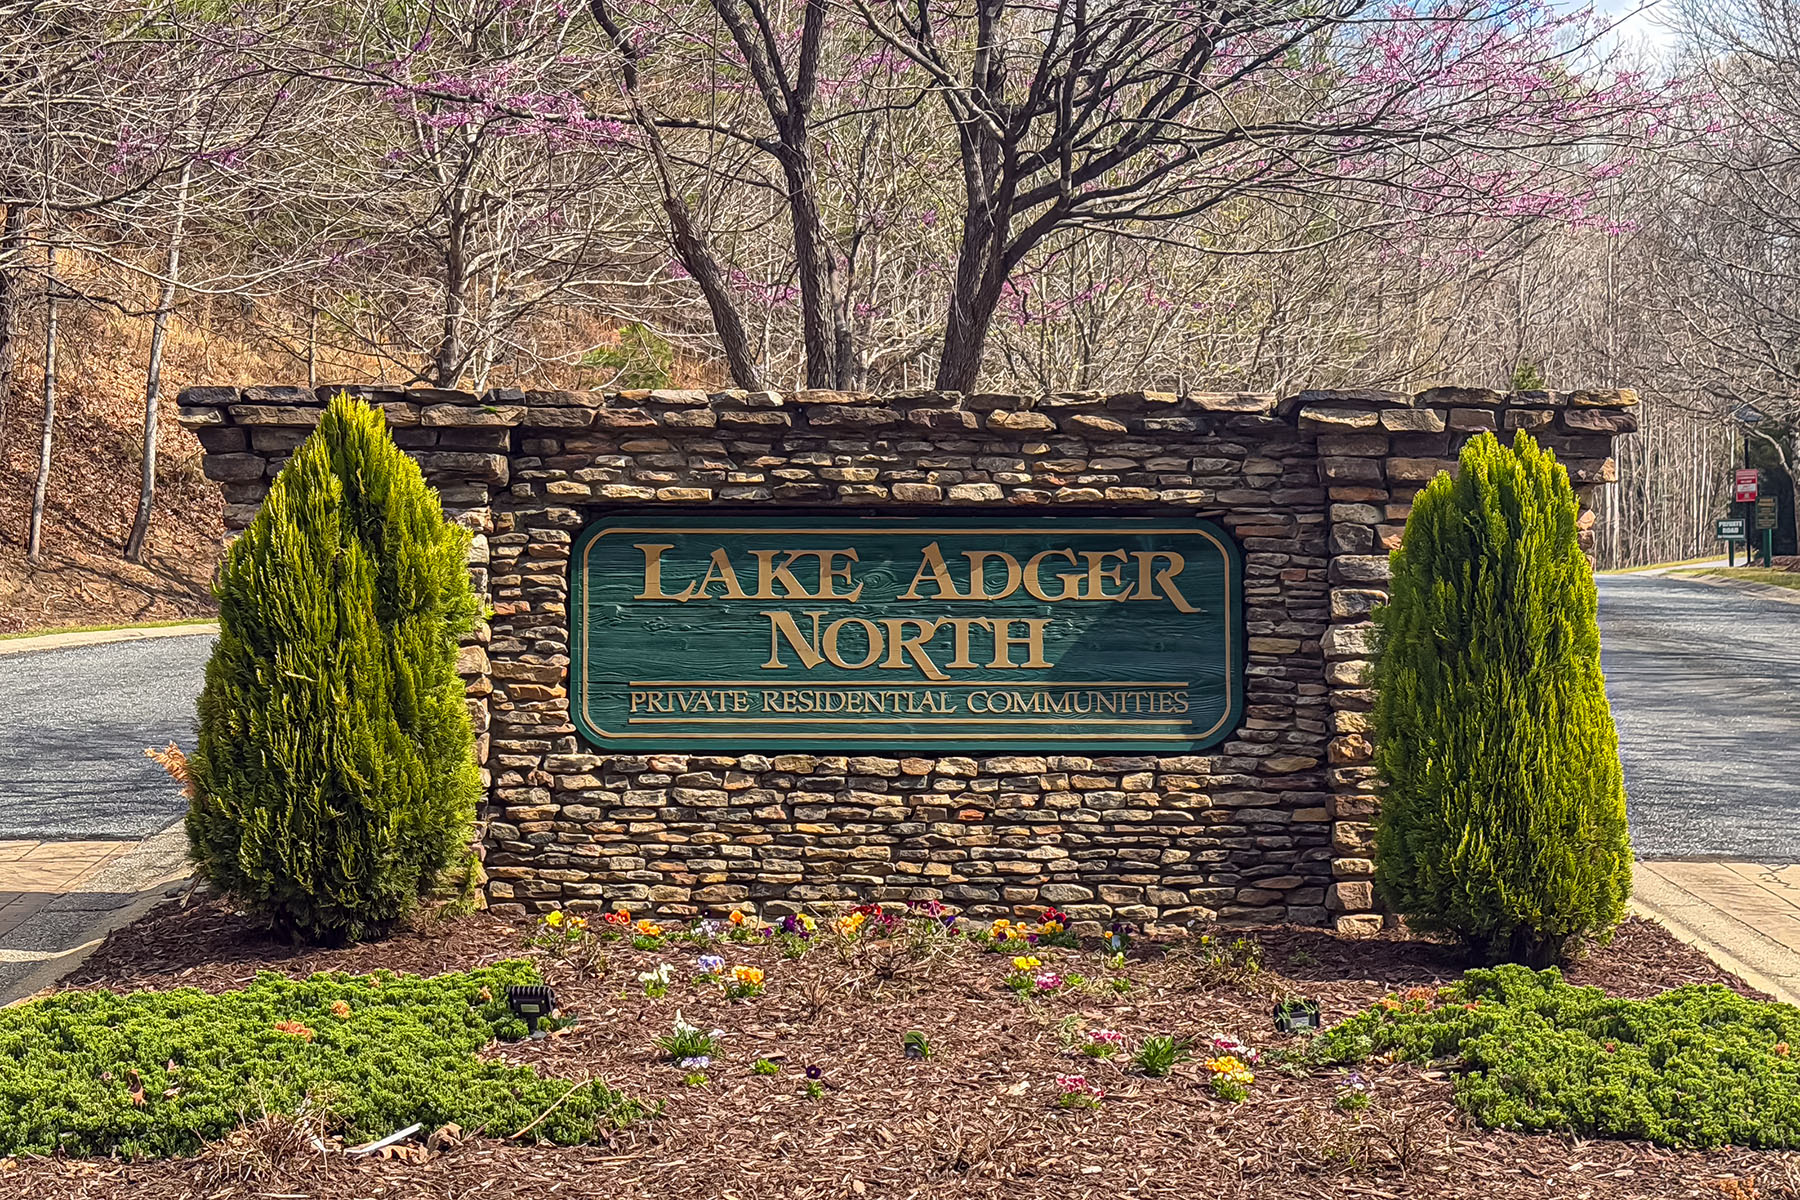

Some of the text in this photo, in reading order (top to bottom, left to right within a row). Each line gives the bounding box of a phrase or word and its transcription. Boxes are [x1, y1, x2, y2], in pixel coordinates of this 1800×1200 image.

[633, 541, 1202, 613] LAKE ADGER
[760, 611, 1054, 680] NORTH
[629, 690, 1189, 714] PRIVATE RESIDENTIAL COMMUNITIES
